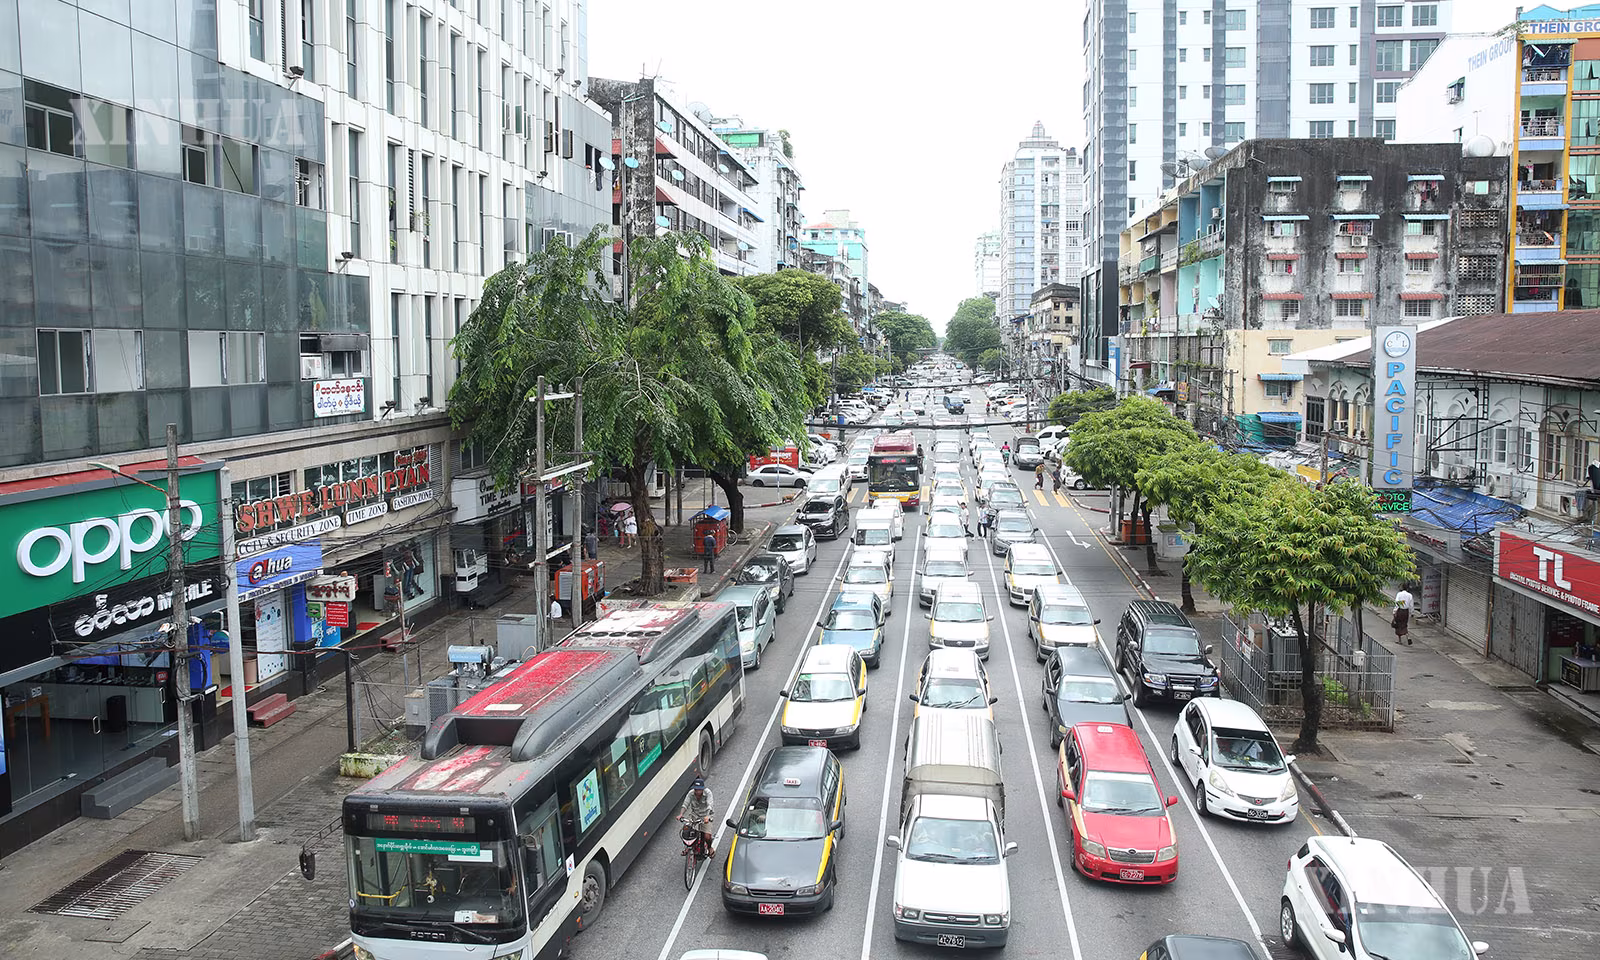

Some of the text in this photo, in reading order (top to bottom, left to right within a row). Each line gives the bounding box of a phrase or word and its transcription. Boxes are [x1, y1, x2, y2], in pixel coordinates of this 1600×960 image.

[1530, 22, 1570, 34] THEIN
[1468, 36, 1515, 72] THEIN GROUP
[1384, 361, 1407, 485] PACIFIC
[237, 463, 430, 533] SHWE LUNN PYAN
[347, 503, 386, 523] TIME ZONE
[394, 490, 432, 509] FASHION ZONE
[480, 492, 498, 506] TIME
[17, 499, 203, 583] oppo
[239, 517, 339, 556] CCTV & SECURITY ZONE
[1533, 546, 1572, 591] TL
[1525, 577, 1541, 590] PHOTO
[1541, 583, 1560, 598] SERVICE
[1564, 592, 1581, 607] PHOTO
[1581, 599, 1600, 614] FRAME
[410, 931, 445, 939] FOTON
